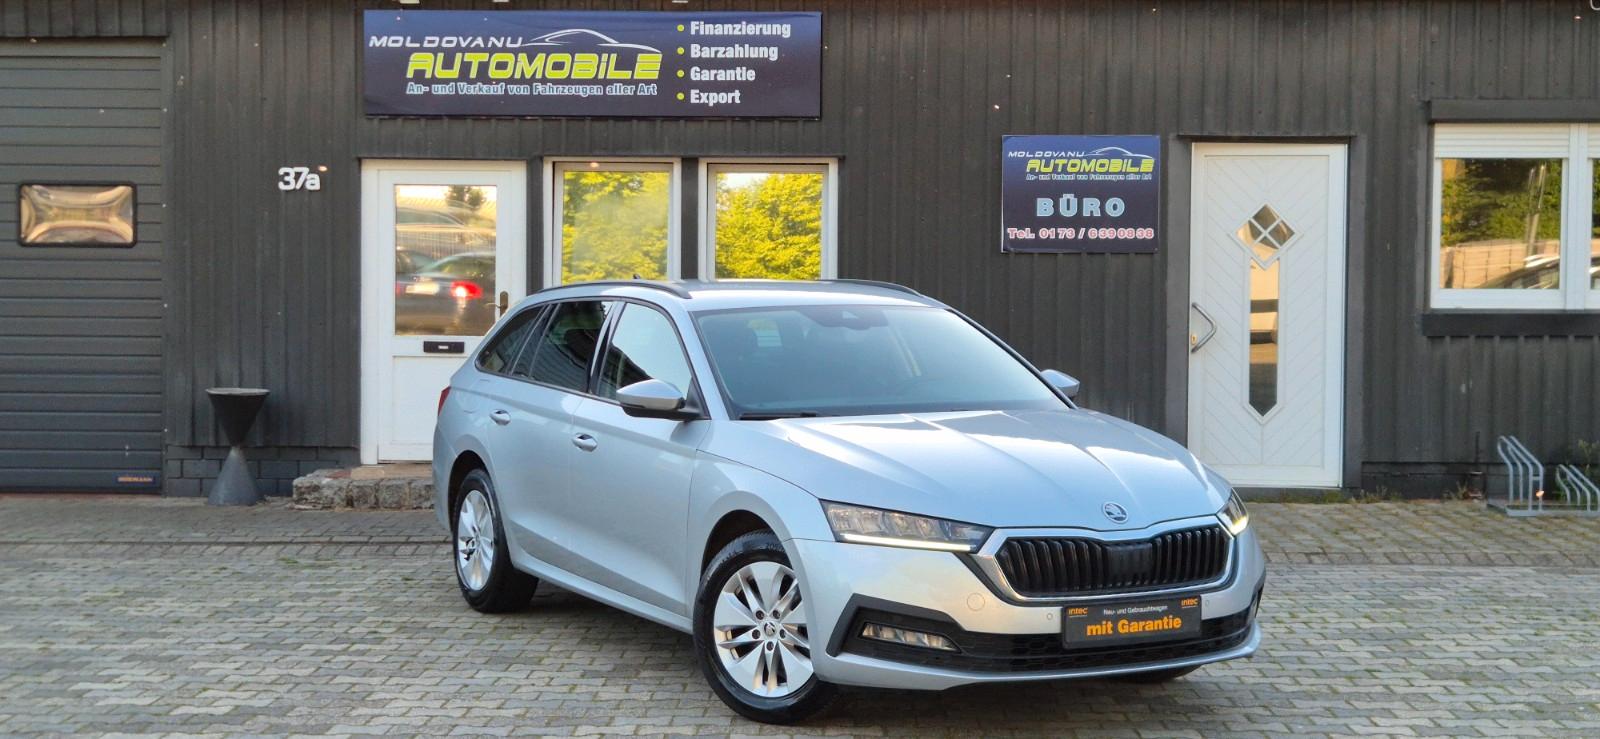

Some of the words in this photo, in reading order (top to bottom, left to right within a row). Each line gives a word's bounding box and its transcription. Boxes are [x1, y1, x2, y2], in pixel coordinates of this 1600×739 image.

[690, 21, 791, 38] Finanzierung
[369, 36, 522, 48] MOLDOVANU
[690, 43, 779, 61] Barzahlung
[690, 66, 756, 81] Garantie
[406, 82, 429, 95] An-
[432, 83, 455, 95] und
[457, 82, 505, 95] Verkauf
[508, 85, 530, 95] von
[533, 83, 603, 97] Fahrzeugen
[606, 83, 635, 95] aller
[637, 83, 657, 95] Art
[690, 89, 741, 106] Export
[278, 166, 321, 191] 37a
[1036, 193, 1125, 217] BÜRO
[1007, 227, 1035, 239] Tel.
[1038, 227, 1076, 239] 0173
[1077, 227, 1086, 239] /
[1088, 227, 1155, 239] 6390838
[1086, 620, 1113, 636] mit
[1118, 615, 1182, 633] Garantie
